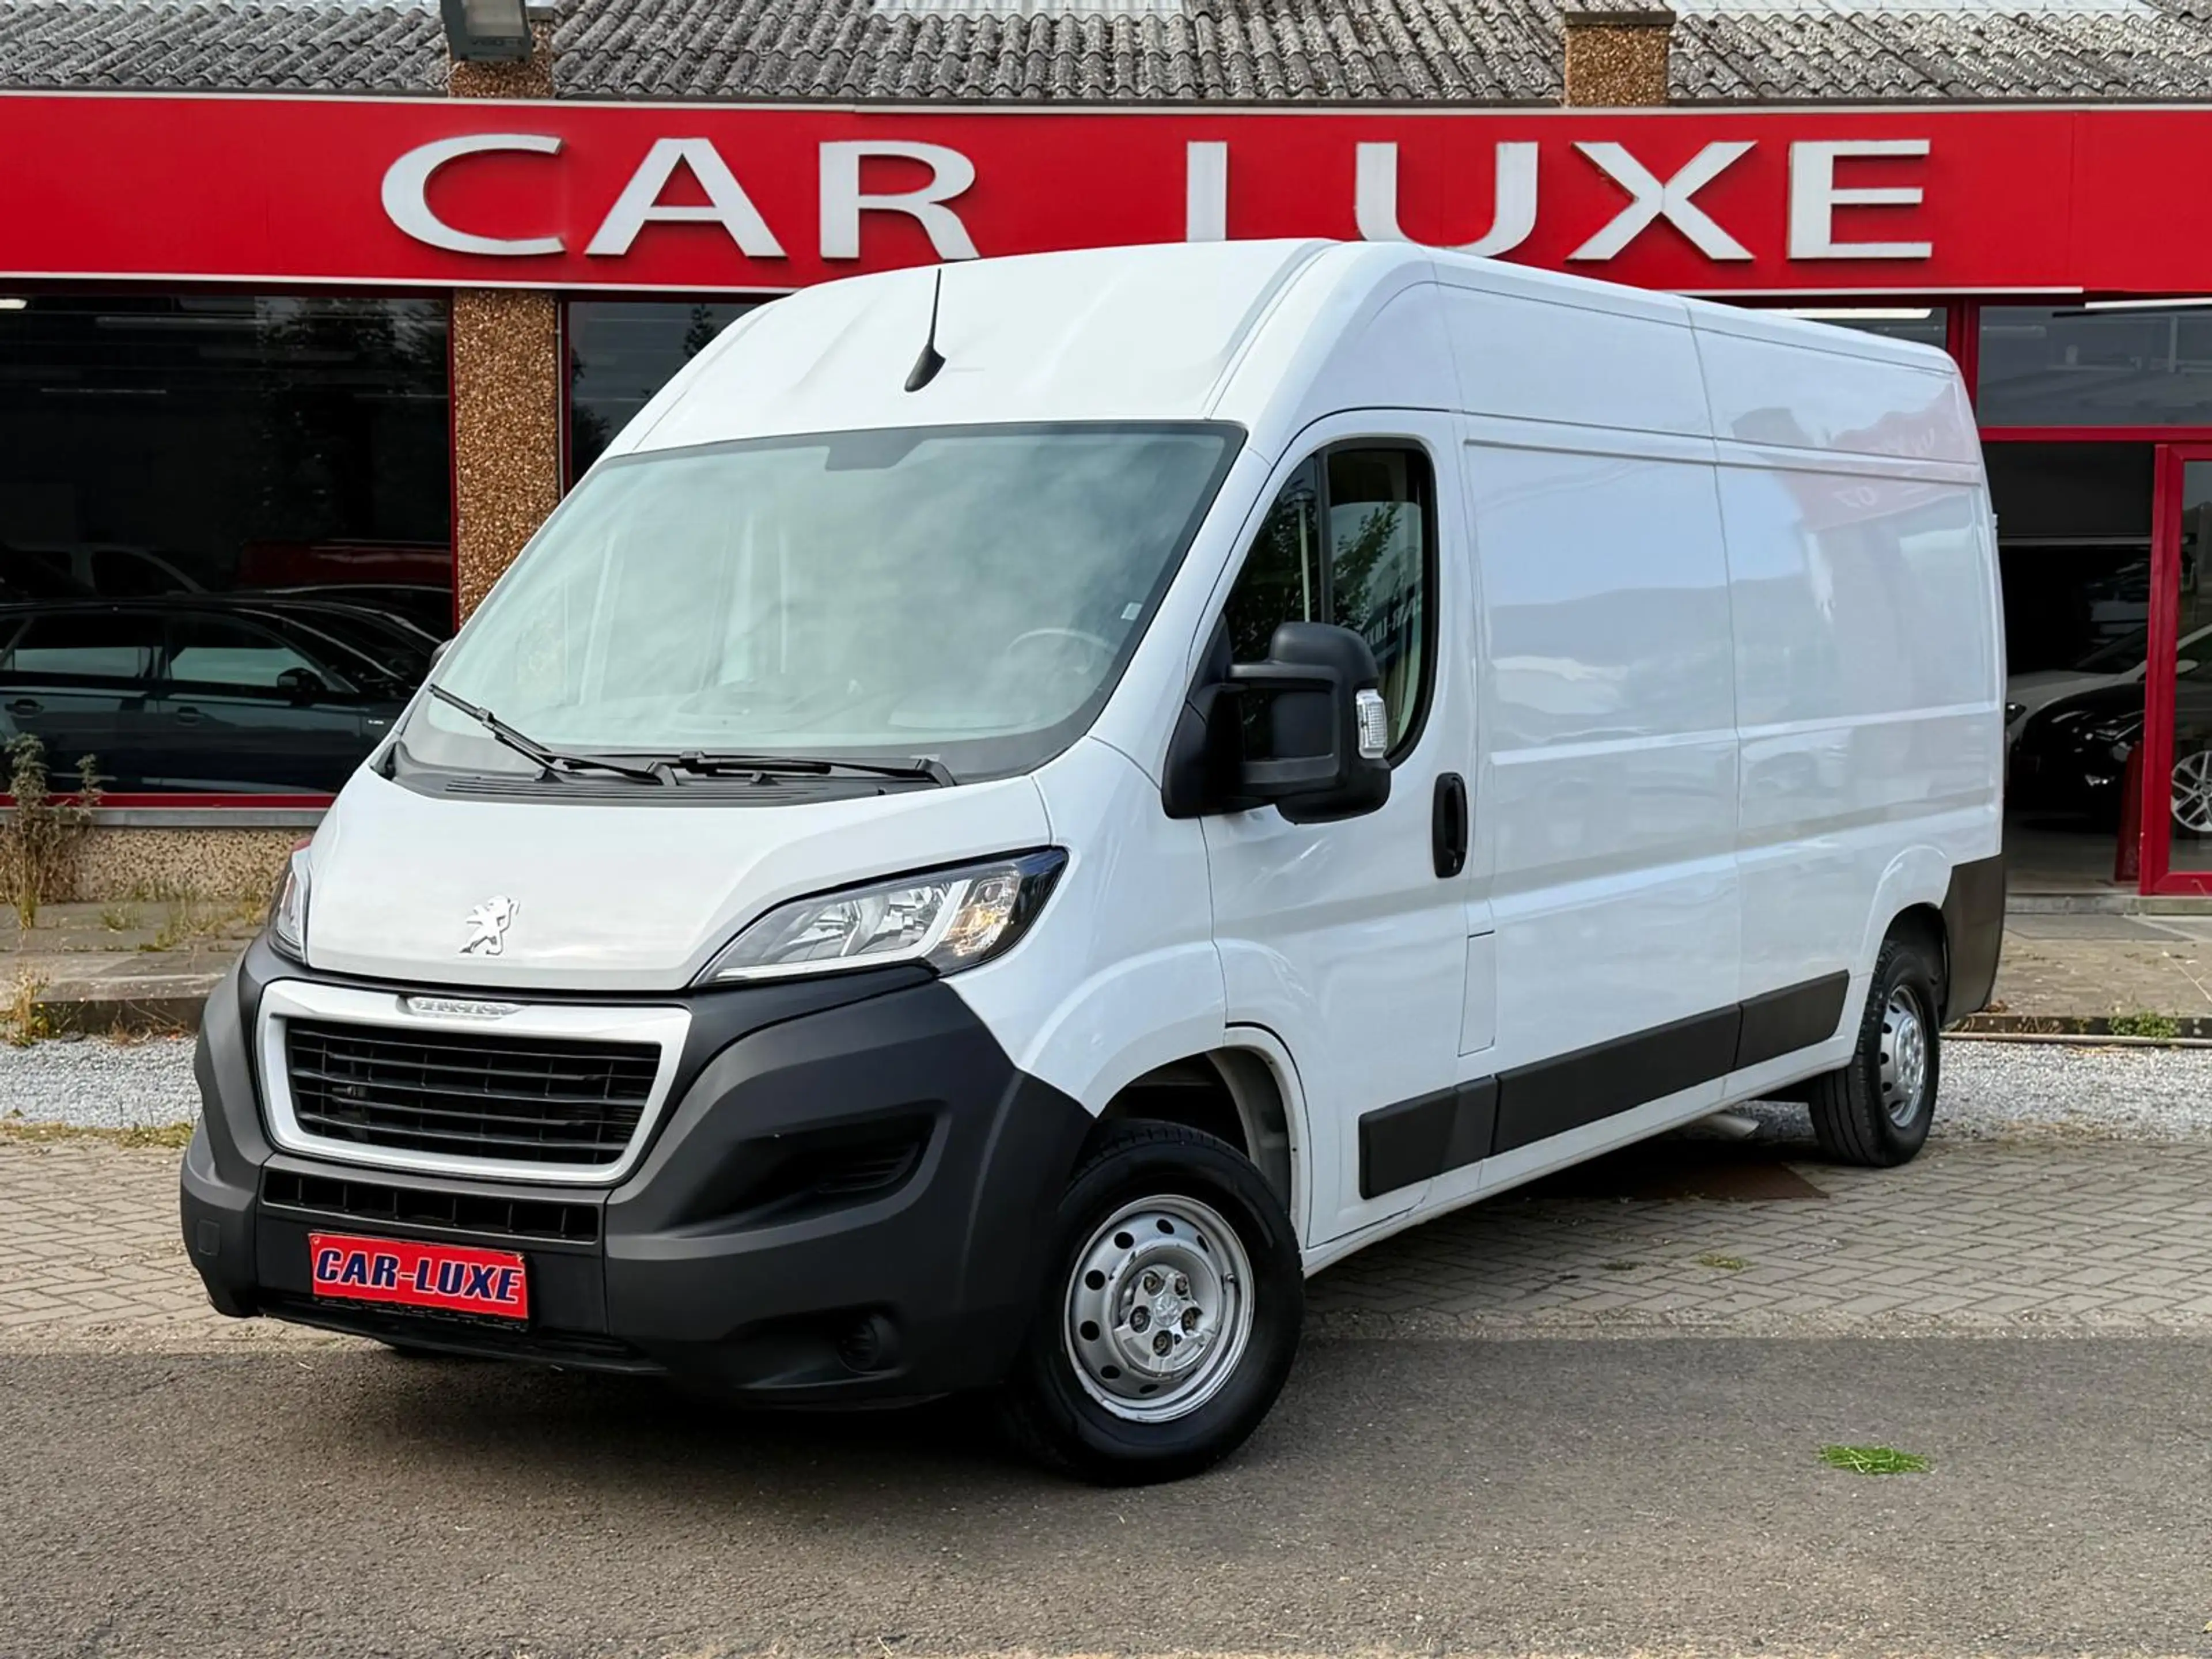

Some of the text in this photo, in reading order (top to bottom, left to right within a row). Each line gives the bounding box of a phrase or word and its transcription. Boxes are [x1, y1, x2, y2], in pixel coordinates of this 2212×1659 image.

[381, 133, 1933, 262] CAR LUXE
[315, 1247, 525, 1304] CAR-LUXE
